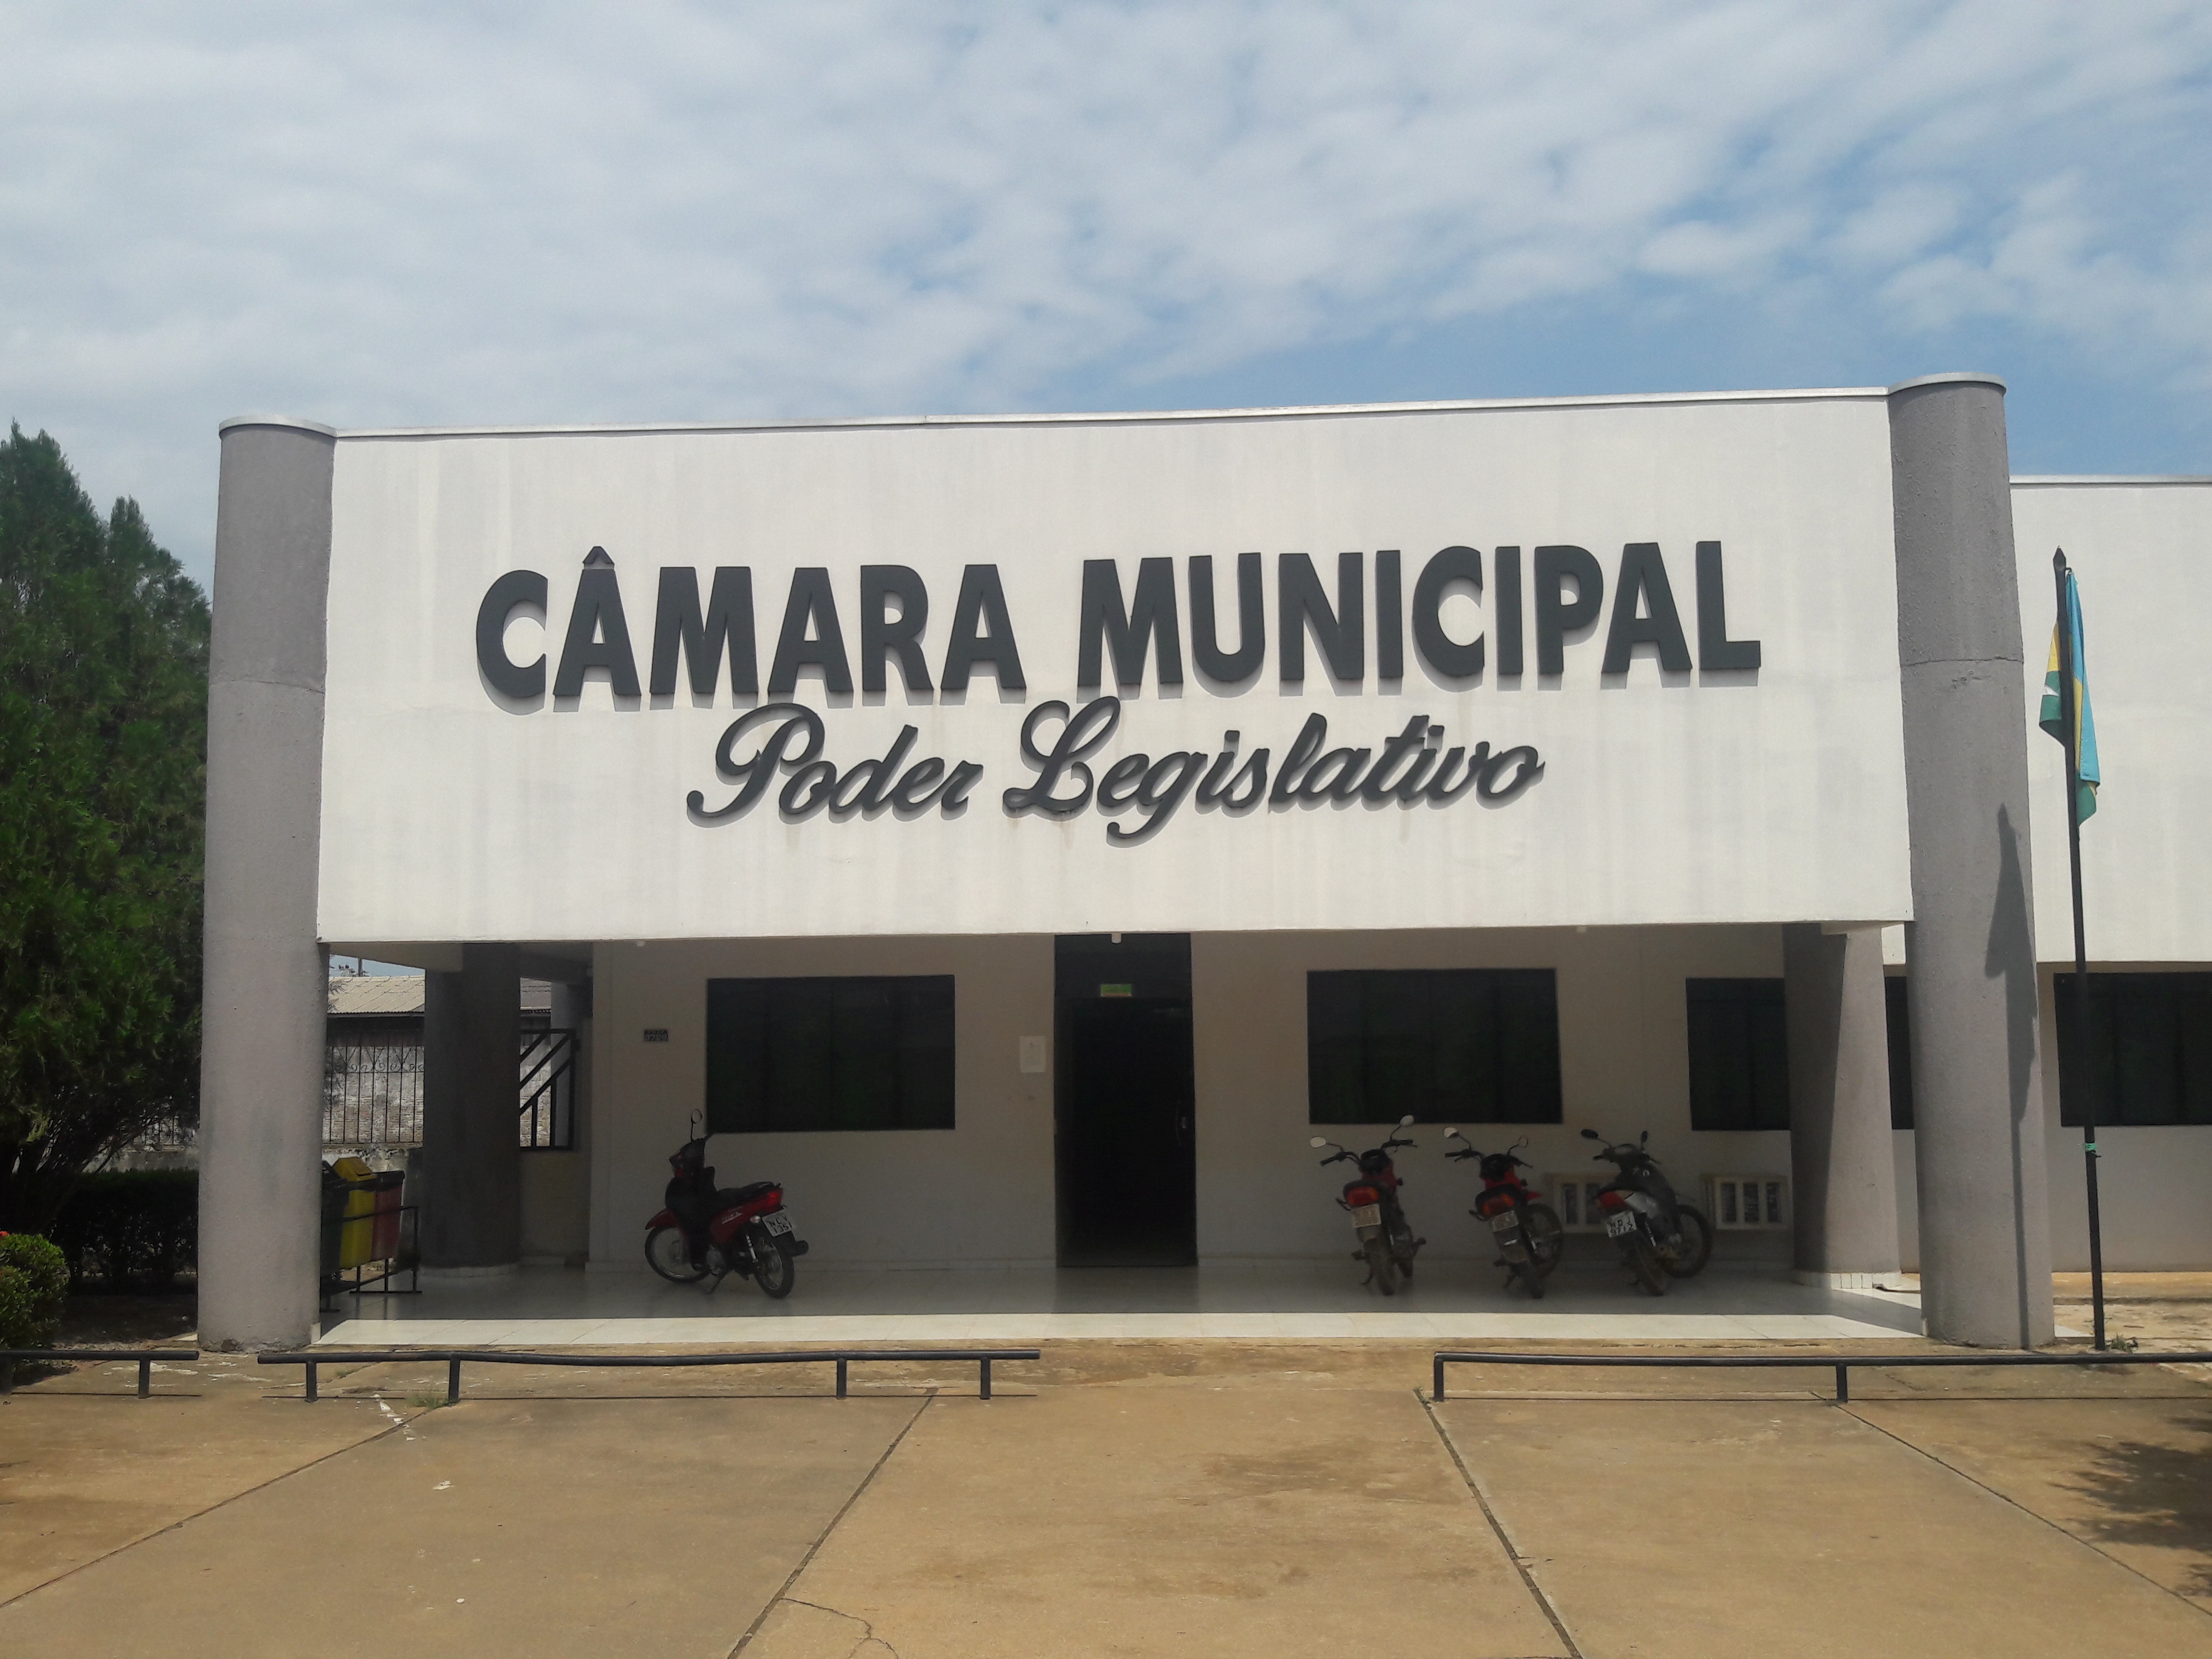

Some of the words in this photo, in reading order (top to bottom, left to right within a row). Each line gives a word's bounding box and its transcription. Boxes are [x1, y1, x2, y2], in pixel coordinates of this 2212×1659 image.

[476, 545, 1027, 703] CÂMARA
[1076, 540, 1762, 697] MUNICIPAL
[686, 703, 984, 823] Poder
[1002, 696, 1546, 843] Legislativo
